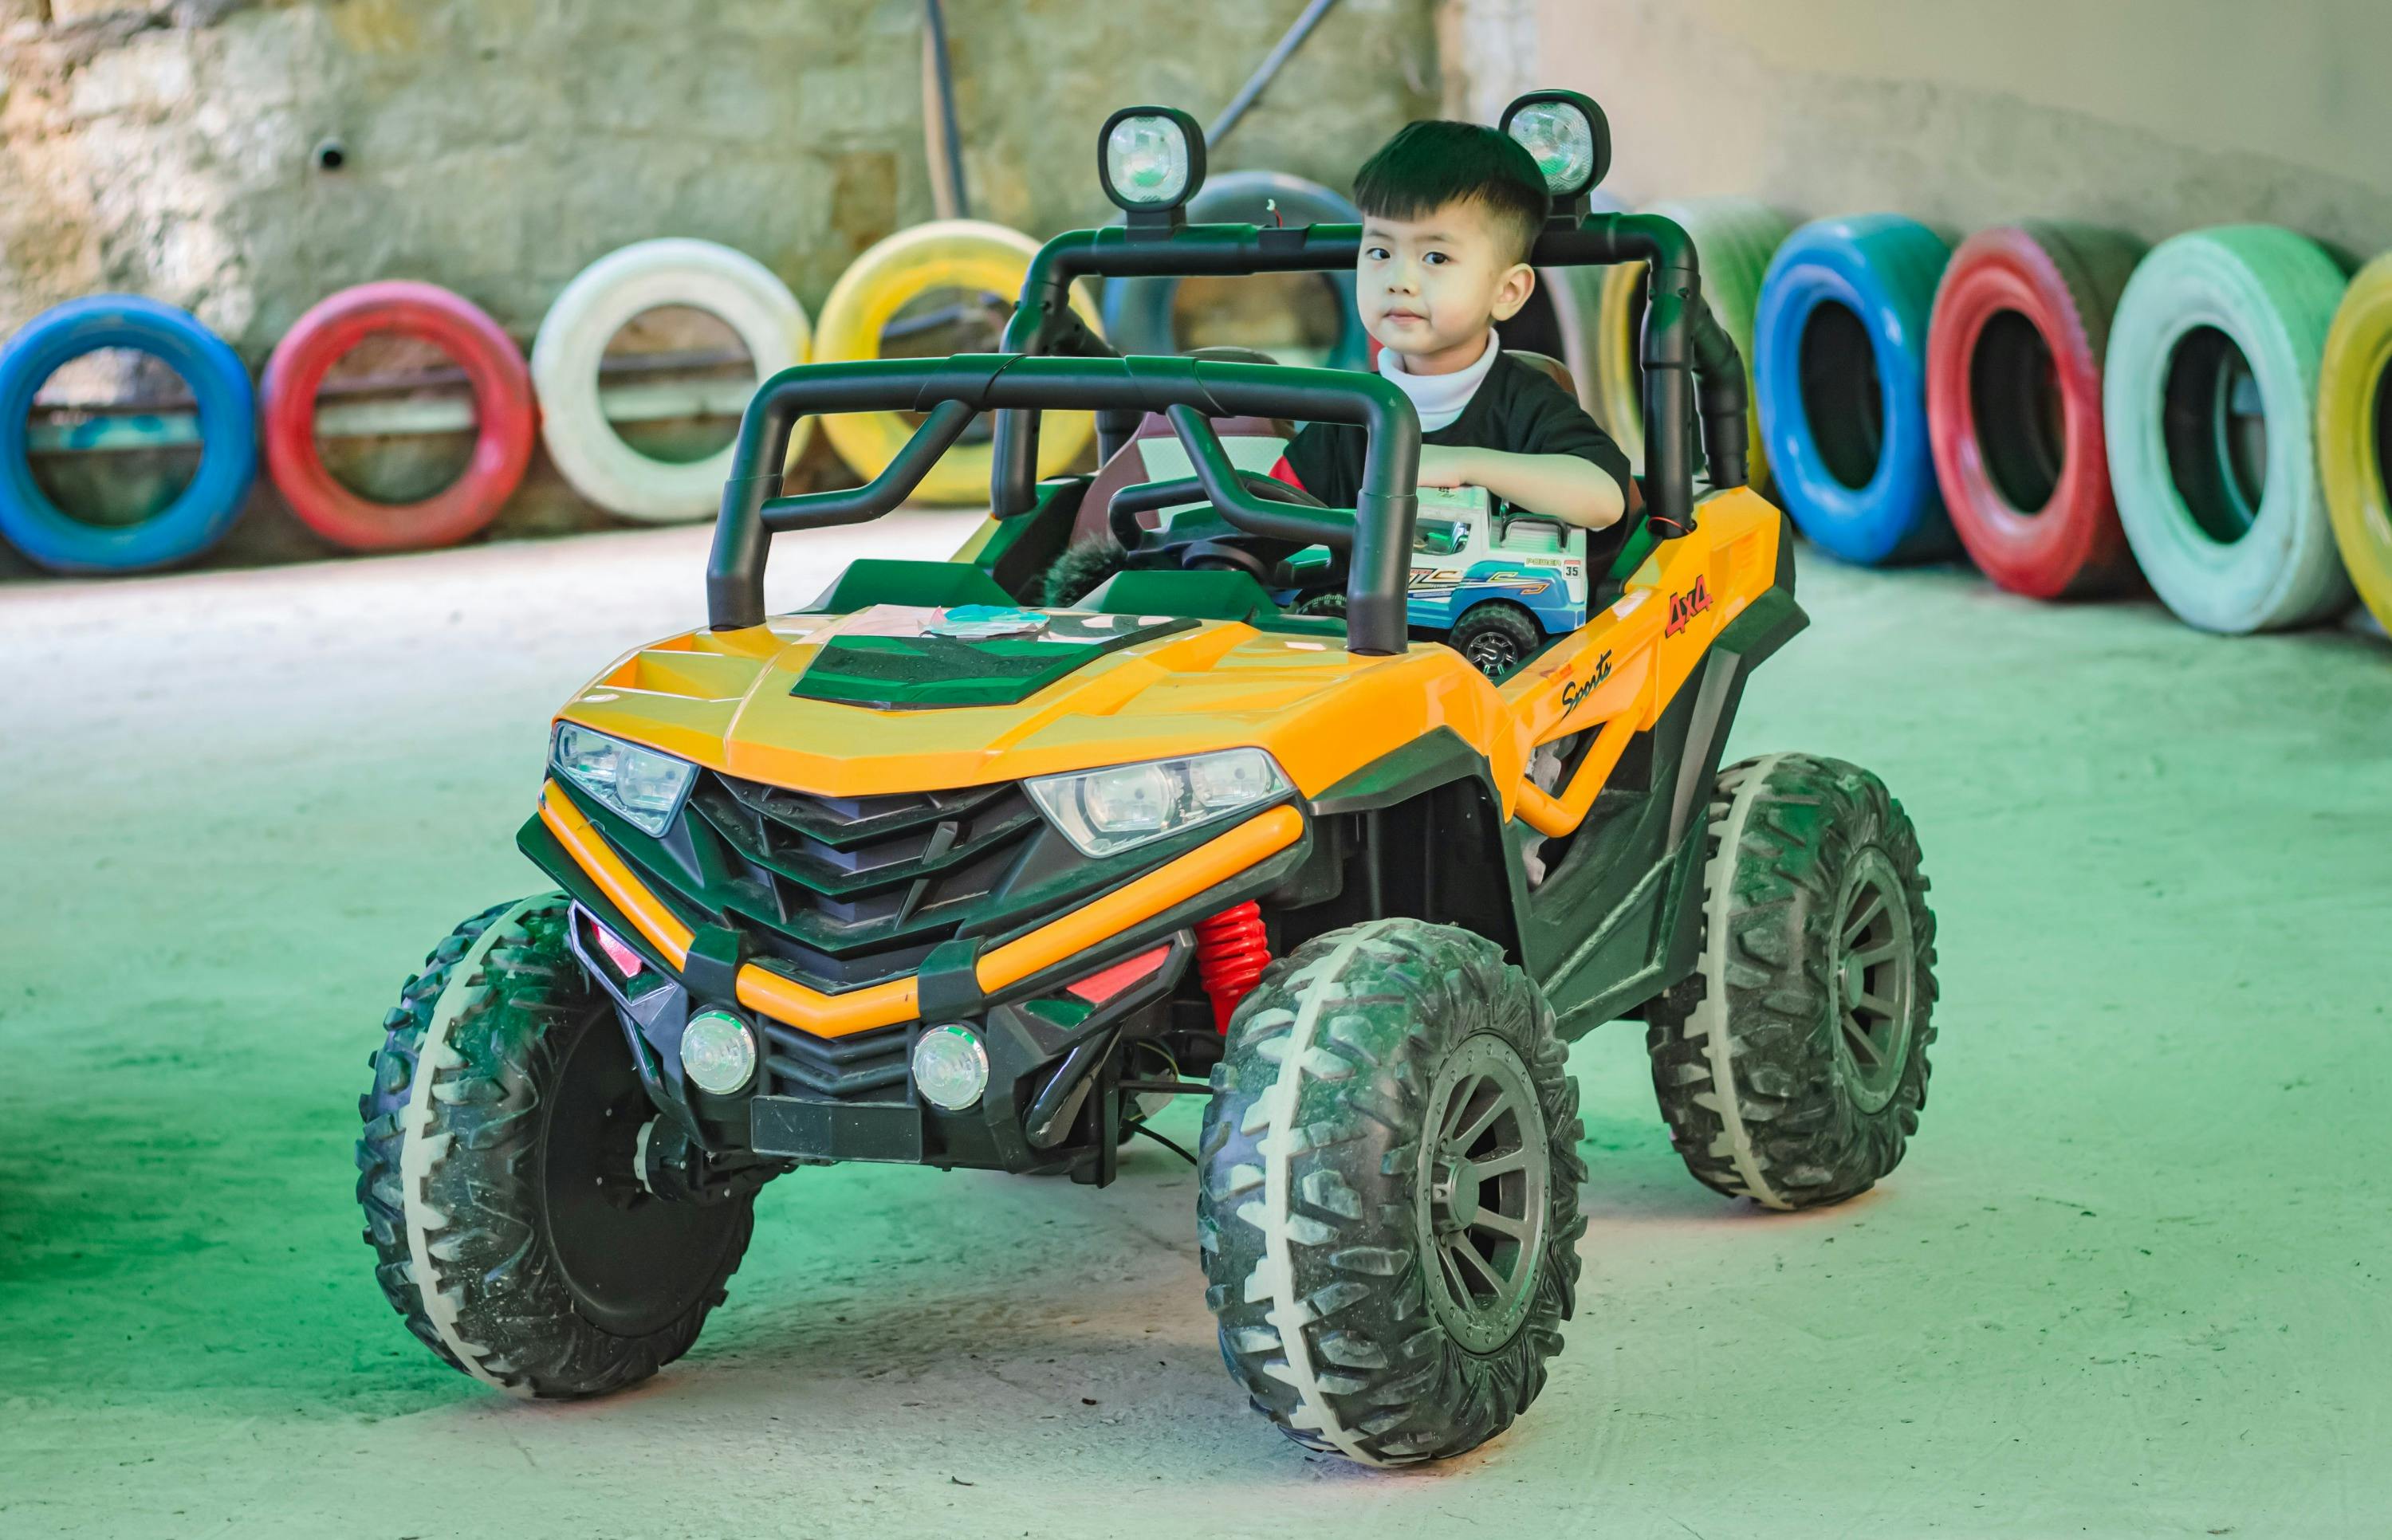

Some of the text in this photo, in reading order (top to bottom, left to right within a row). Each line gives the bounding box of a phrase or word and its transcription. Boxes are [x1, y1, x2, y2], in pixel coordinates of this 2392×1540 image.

[1566, 567, 1579, 576] 35
[1665, 574, 1713, 639] 4x4
[1561, 649, 1611, 719] Sports
